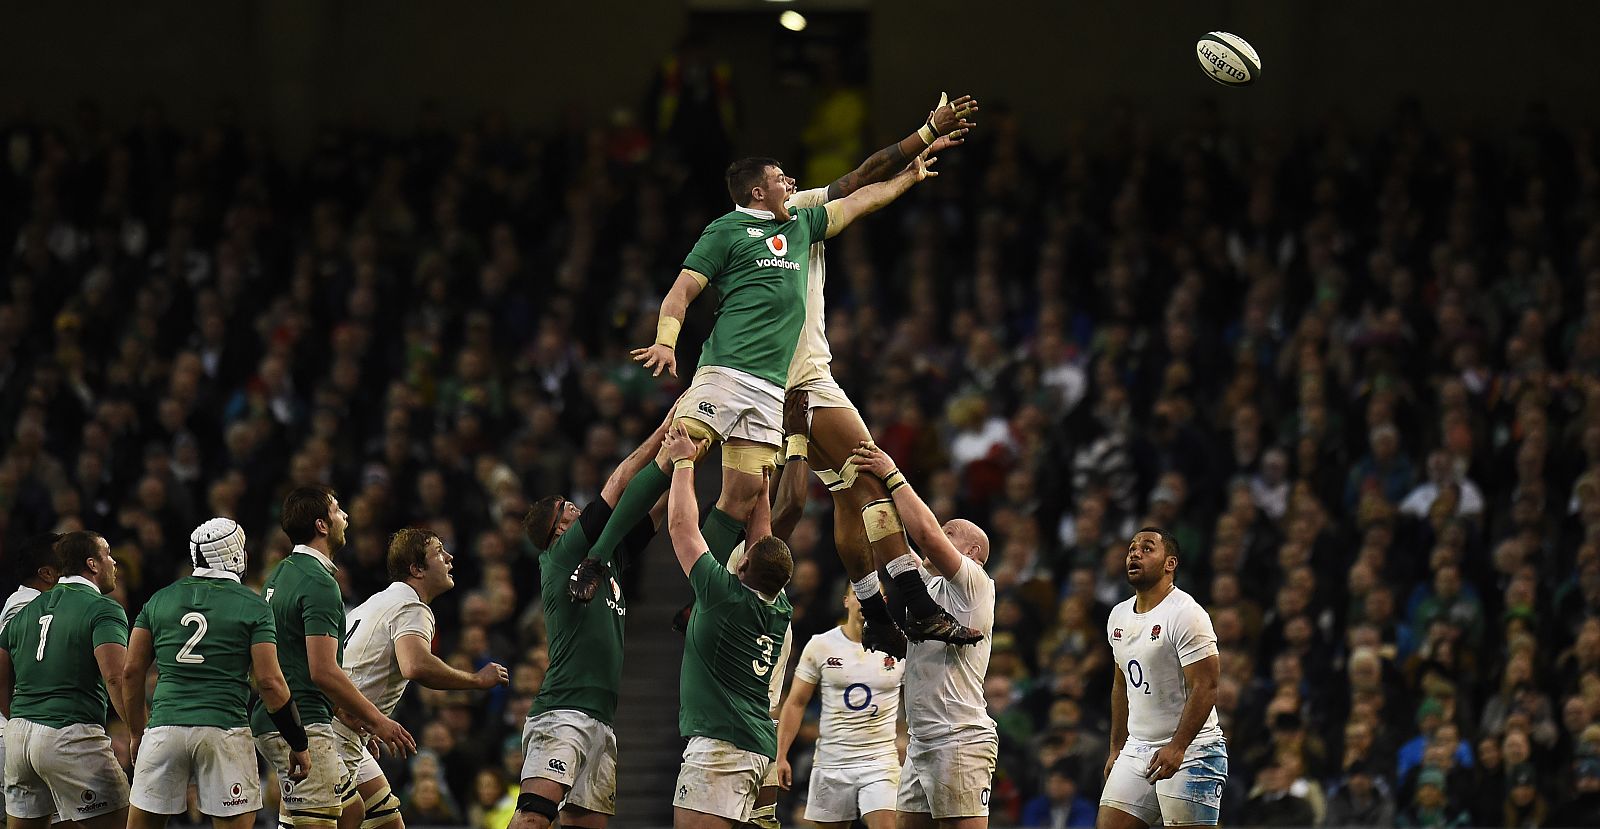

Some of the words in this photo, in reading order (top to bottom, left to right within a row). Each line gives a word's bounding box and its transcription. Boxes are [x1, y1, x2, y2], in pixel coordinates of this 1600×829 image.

[1199, 45, 1246, 81] GILBERT
[755, 256, 801, 271] vodafone
[36, 614, 54, 662] 1
[175, 612, 208, 664] 2
[752, 634, 774, 677] 3
